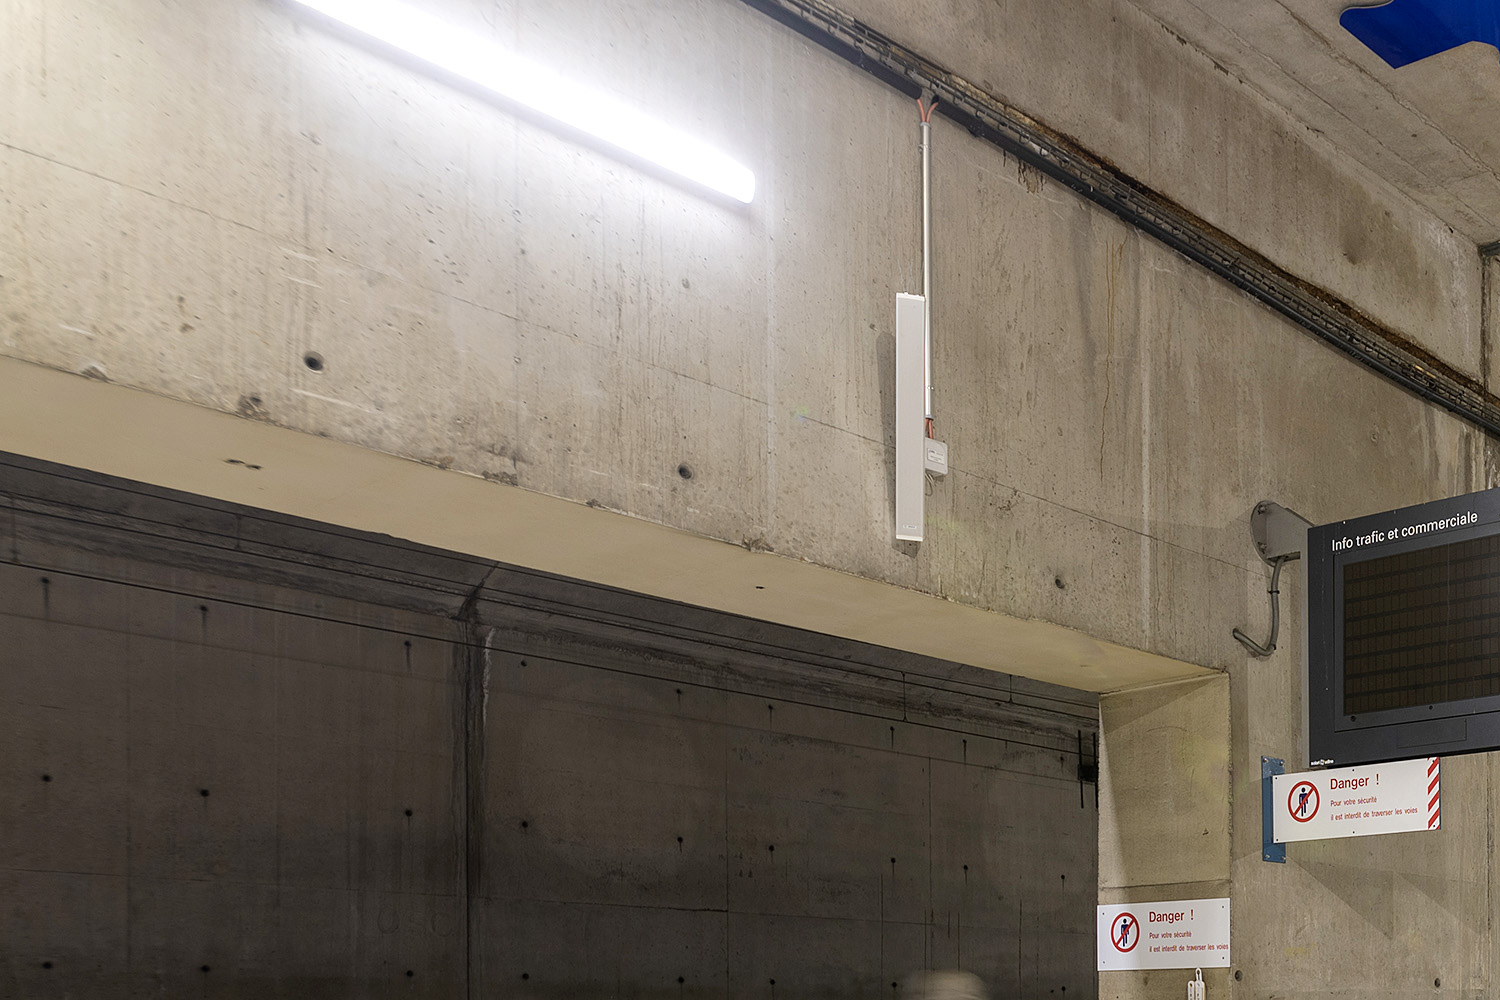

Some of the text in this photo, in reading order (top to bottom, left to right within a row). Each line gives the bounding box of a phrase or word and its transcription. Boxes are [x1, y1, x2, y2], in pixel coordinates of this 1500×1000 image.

[1332, 511, 1478, 551] Info trafic et commerciale
[1330, 777, 1369, 790] Danger
[1358, 796, 1377, 804] sécurité
[1149, 912, 1184, 924] Danger
